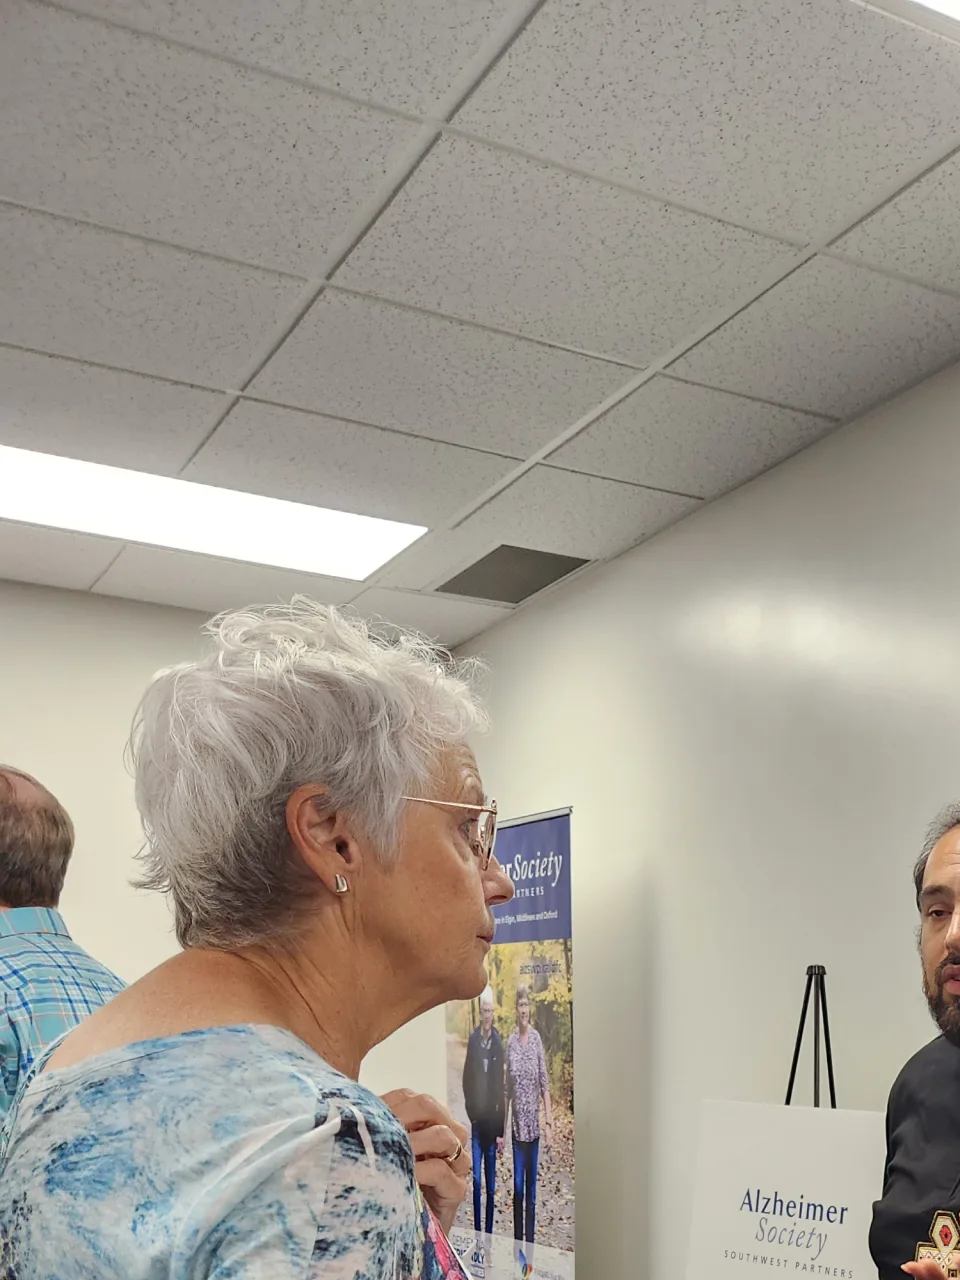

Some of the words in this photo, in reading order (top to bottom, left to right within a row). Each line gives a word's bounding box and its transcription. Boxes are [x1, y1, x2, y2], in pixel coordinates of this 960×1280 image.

[512, 851, 563, 887] Society
[740, 1188, 848, 1224] Alzheimer
[755, 1217, 828, 1261] Society
[724, 1250, 789, 1268] SOUTHWEST
[795, 1261, 853, 1279] PARTNERS
